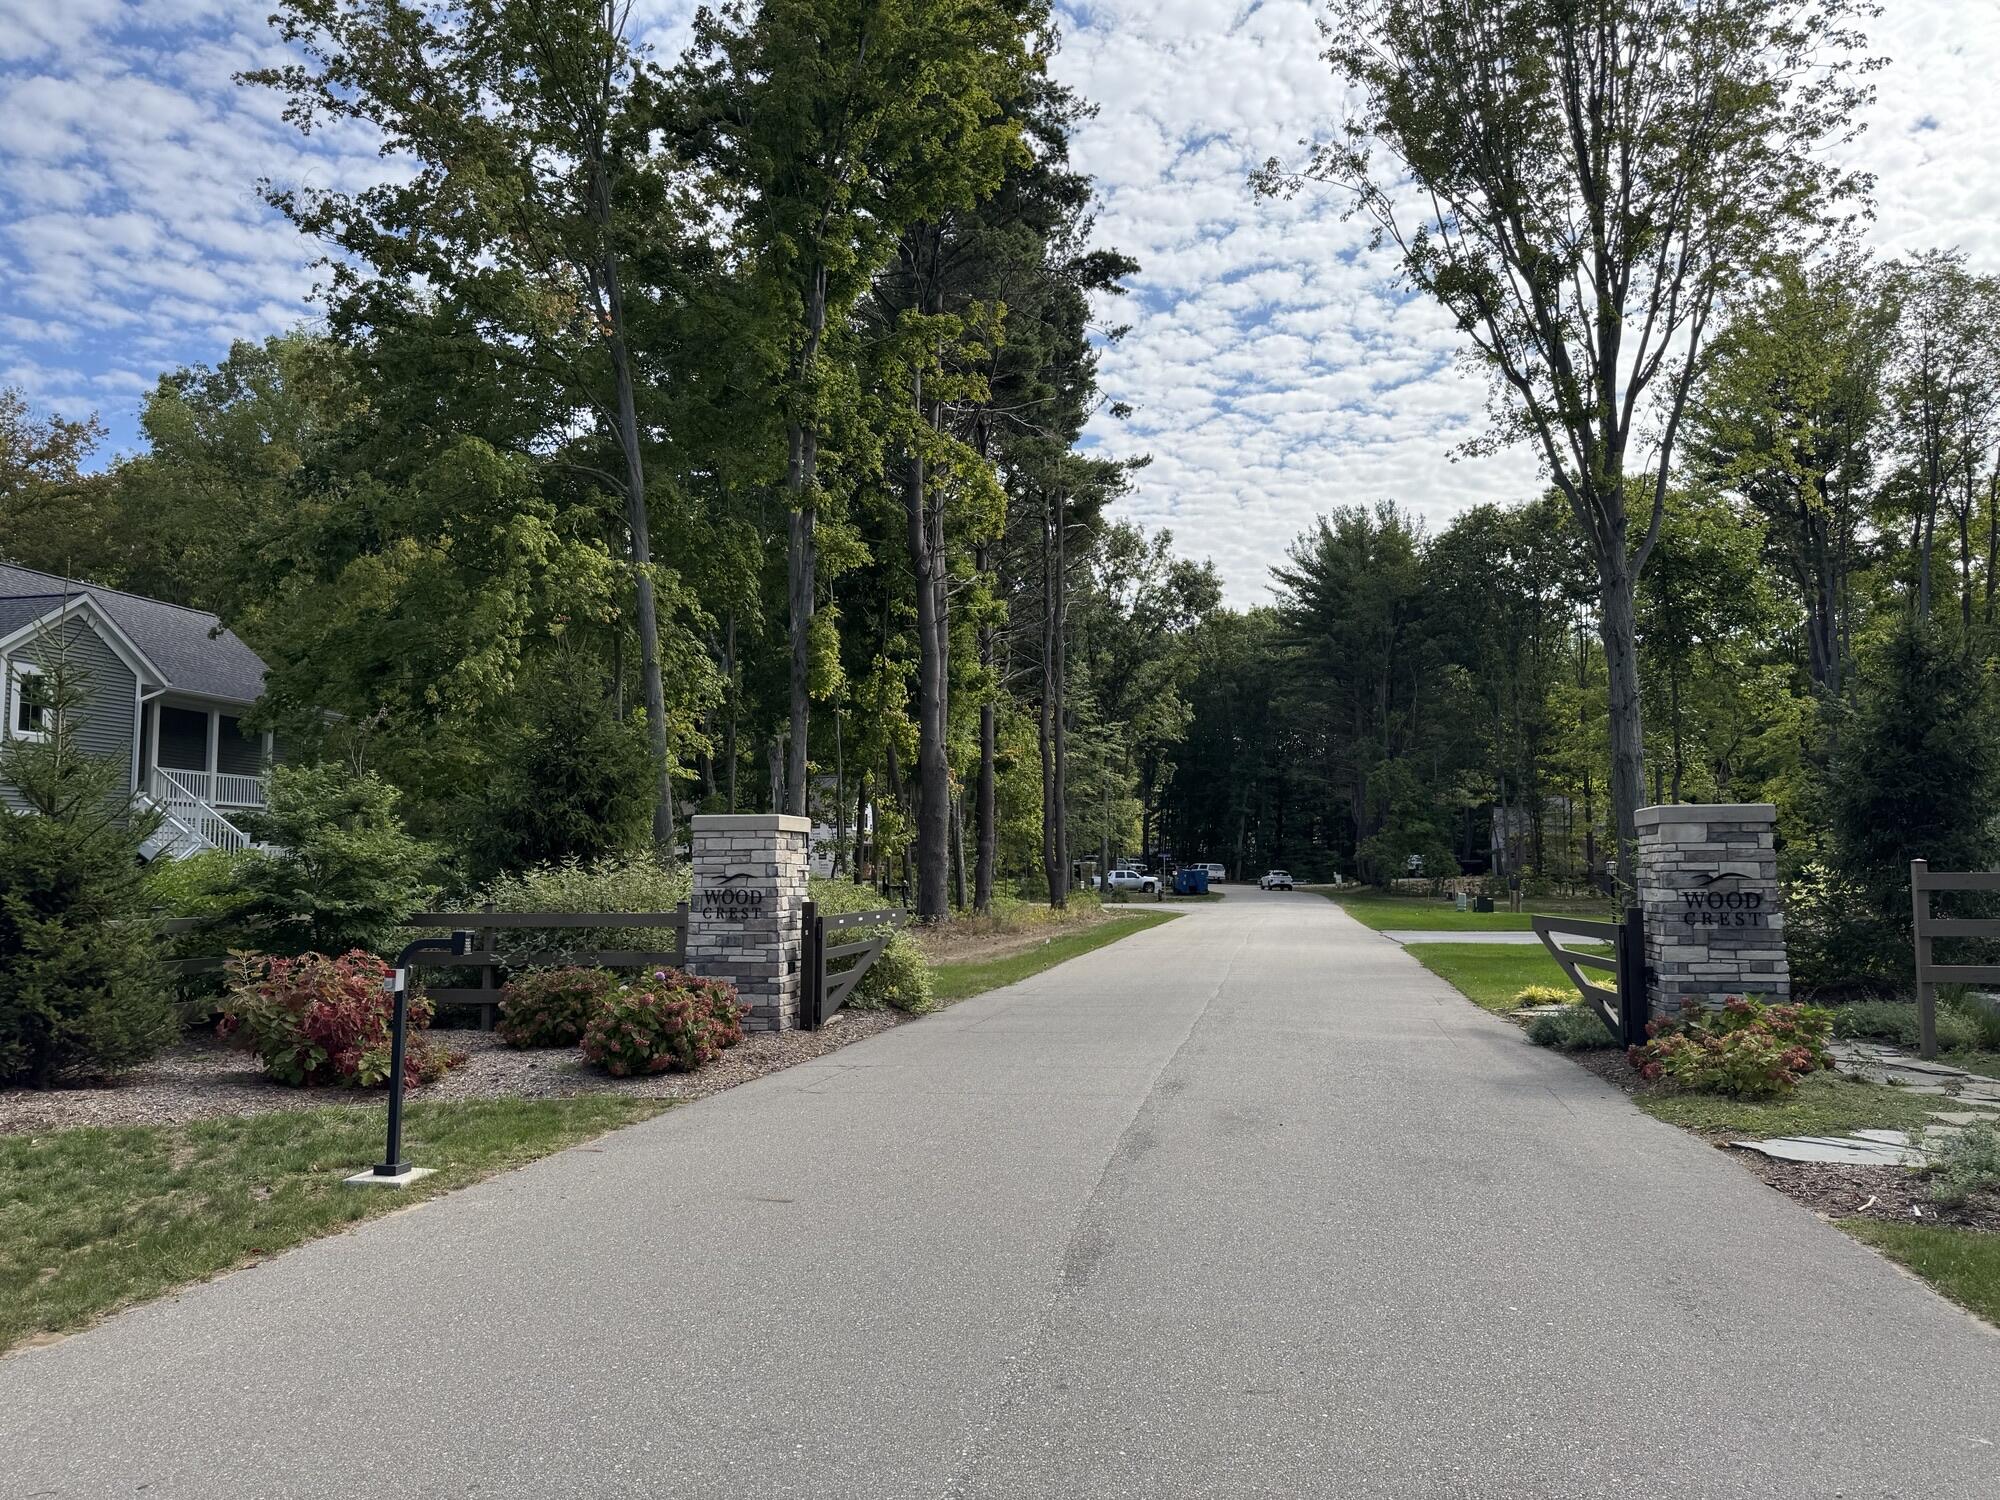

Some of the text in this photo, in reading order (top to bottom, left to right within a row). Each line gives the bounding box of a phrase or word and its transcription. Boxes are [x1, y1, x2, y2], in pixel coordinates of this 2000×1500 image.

[703, 889, 762, 905] WOOD
[1681, 891, 1762, 910] WOOD
[702, 907, 762, 920] CREST
[1684, 911, 1762, 926] CREST
